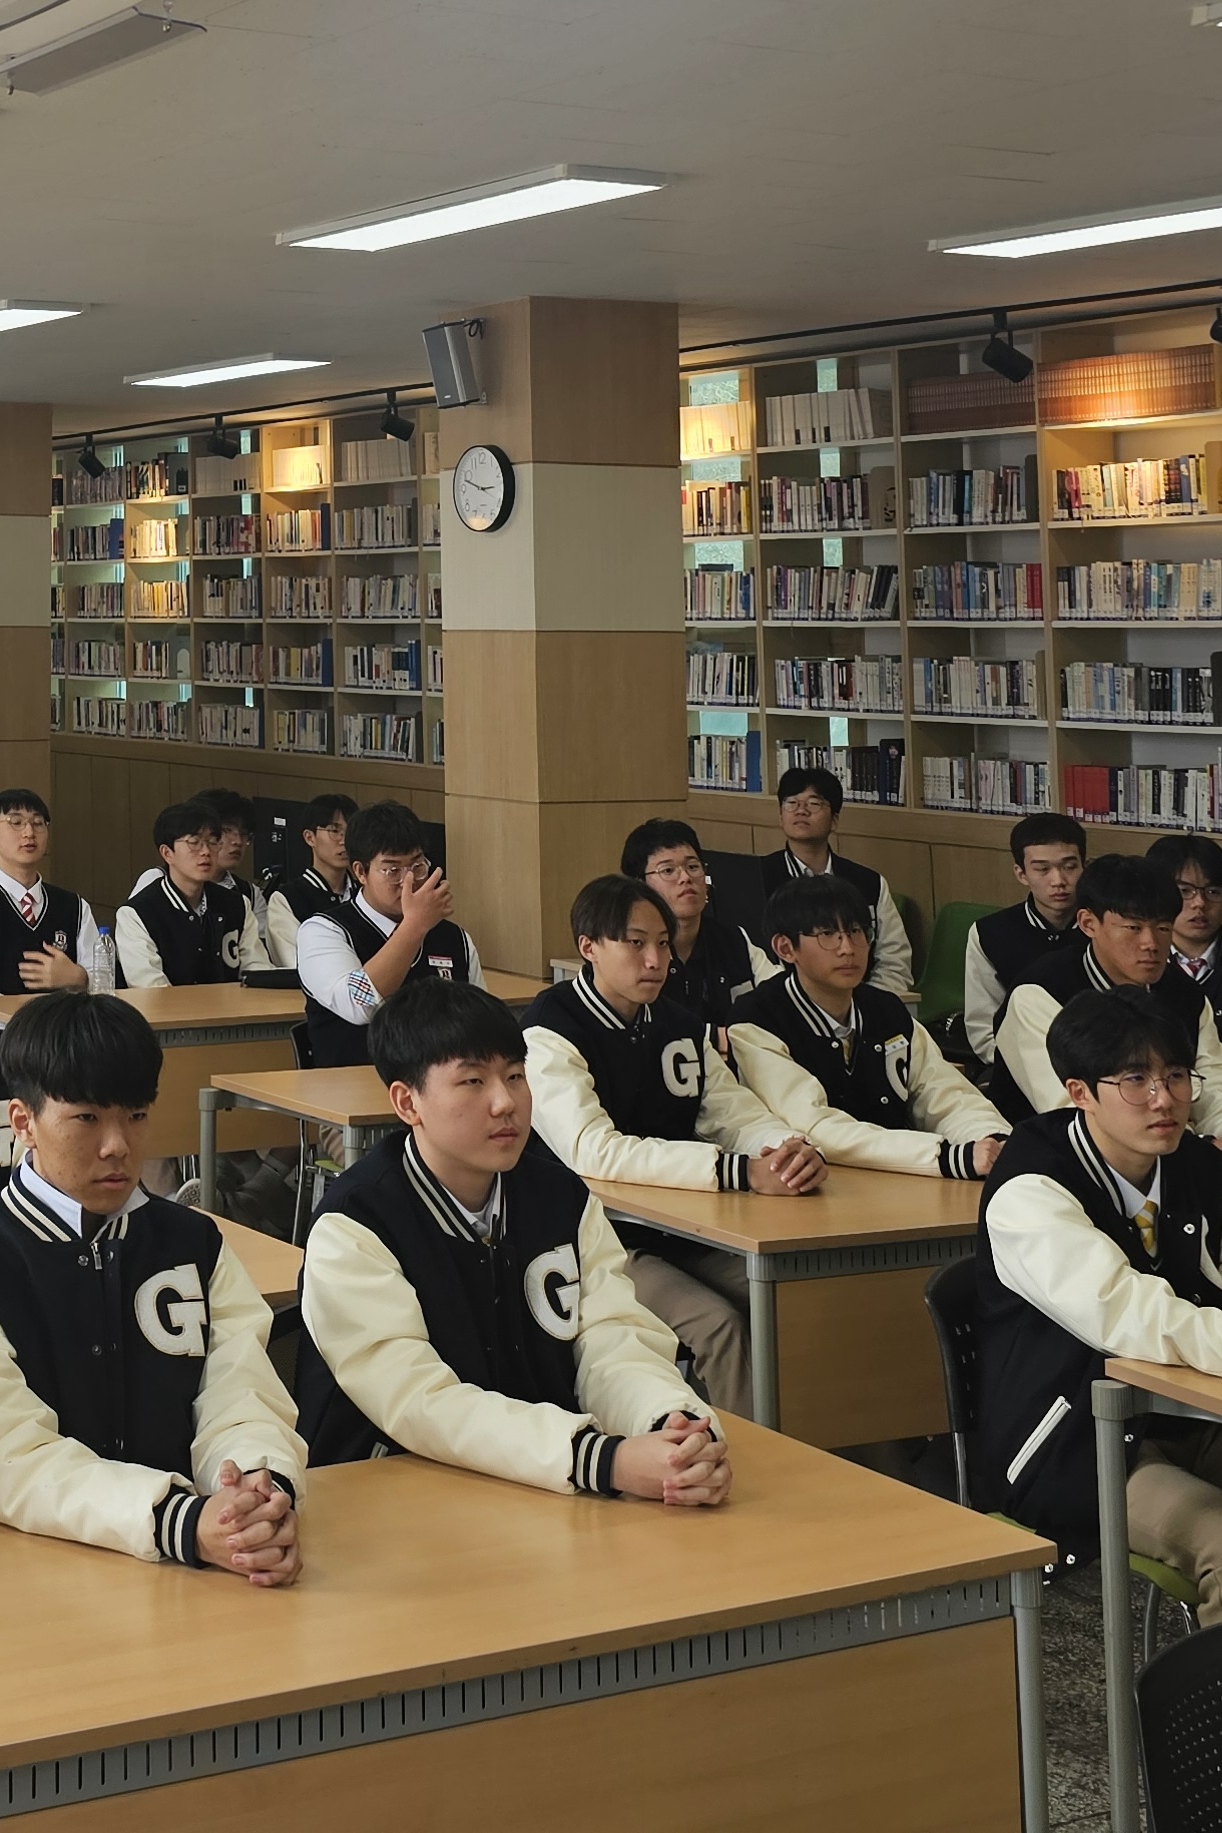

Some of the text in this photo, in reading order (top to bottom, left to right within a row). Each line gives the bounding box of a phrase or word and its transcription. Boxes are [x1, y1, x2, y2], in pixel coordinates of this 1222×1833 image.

[471, 457, 477, 470] 11
[479, 452, 487, 465] 12
[220, 928, 241, 970] G
[661, 1036, 703, 1098] G
[133, 1261, 209, 1358] G
[522, 1242, 581, 1342] G
